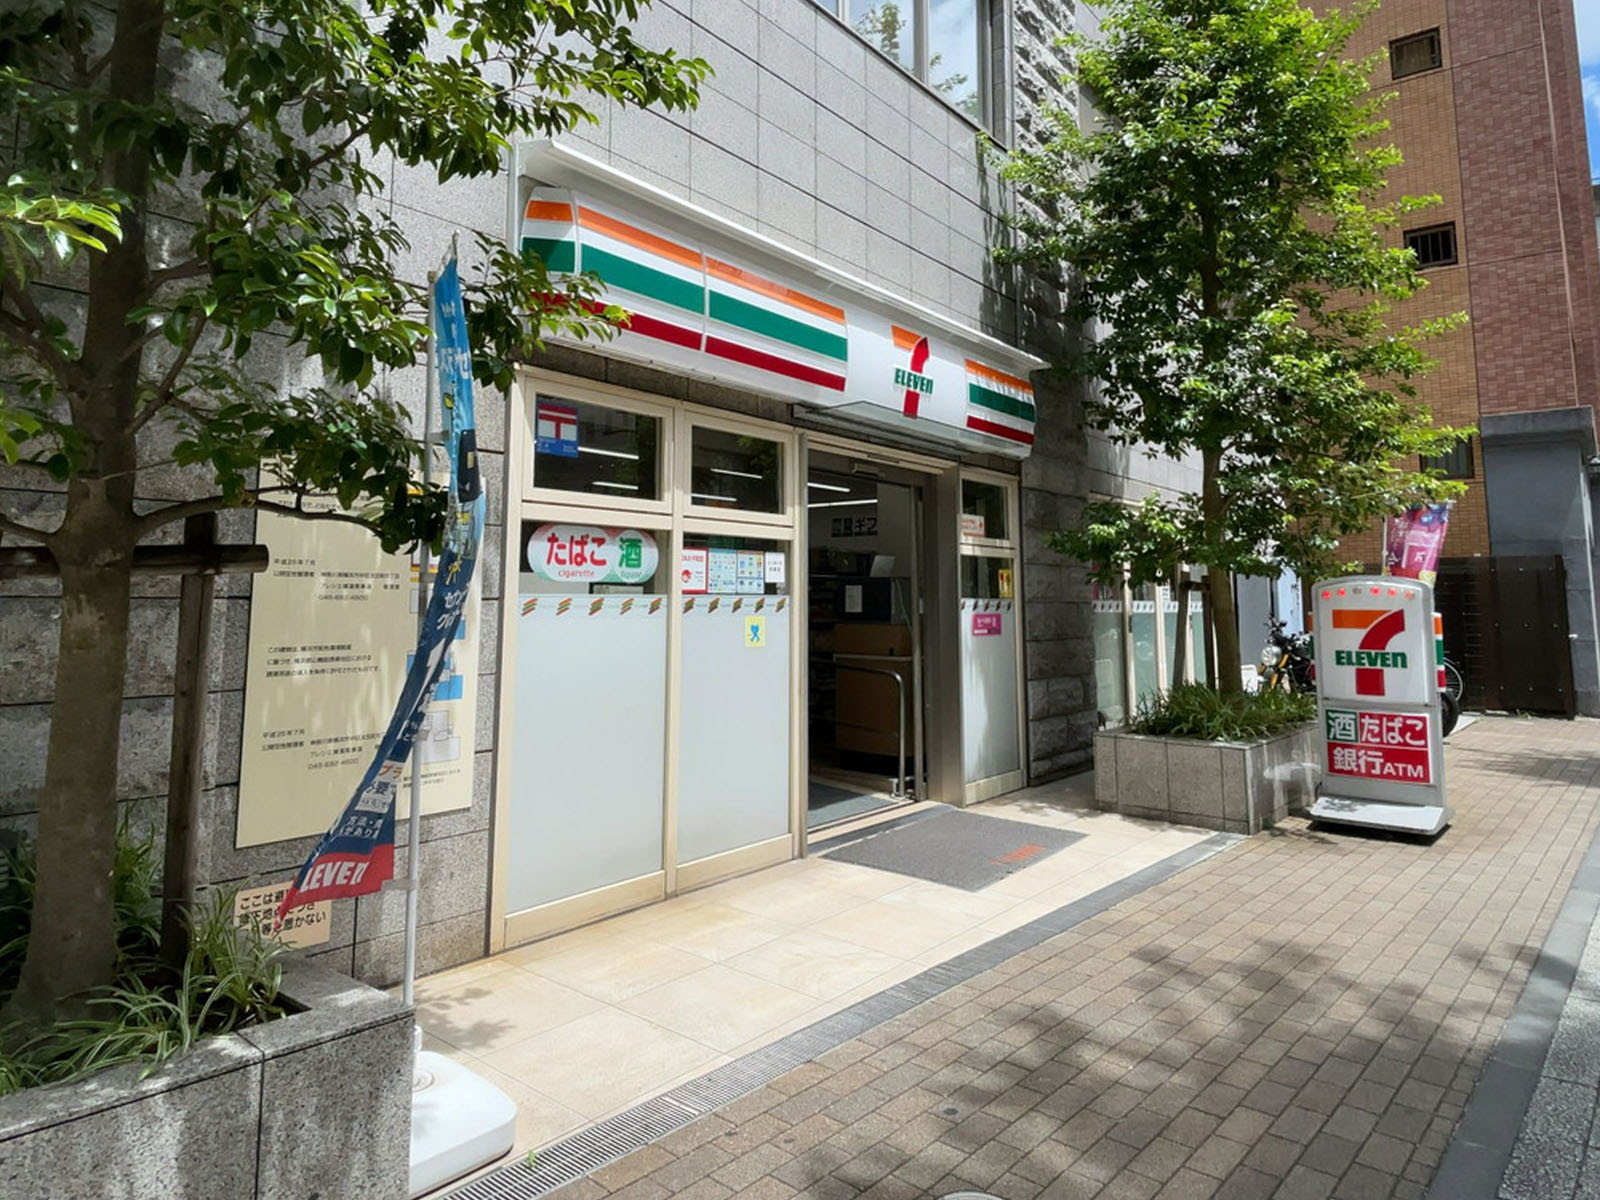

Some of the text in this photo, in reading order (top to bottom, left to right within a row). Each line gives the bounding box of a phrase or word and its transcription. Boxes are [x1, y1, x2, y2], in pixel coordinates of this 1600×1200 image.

[546, 532, 642, 569] たばこ 酒
[558, 568, 595, 579] cigarette
[1332, 609, 1405, 696] 7
[1327, 713, 1426, 746] 酒 たばこ
[1333, 747, 1424, 779] 銀行ATM
